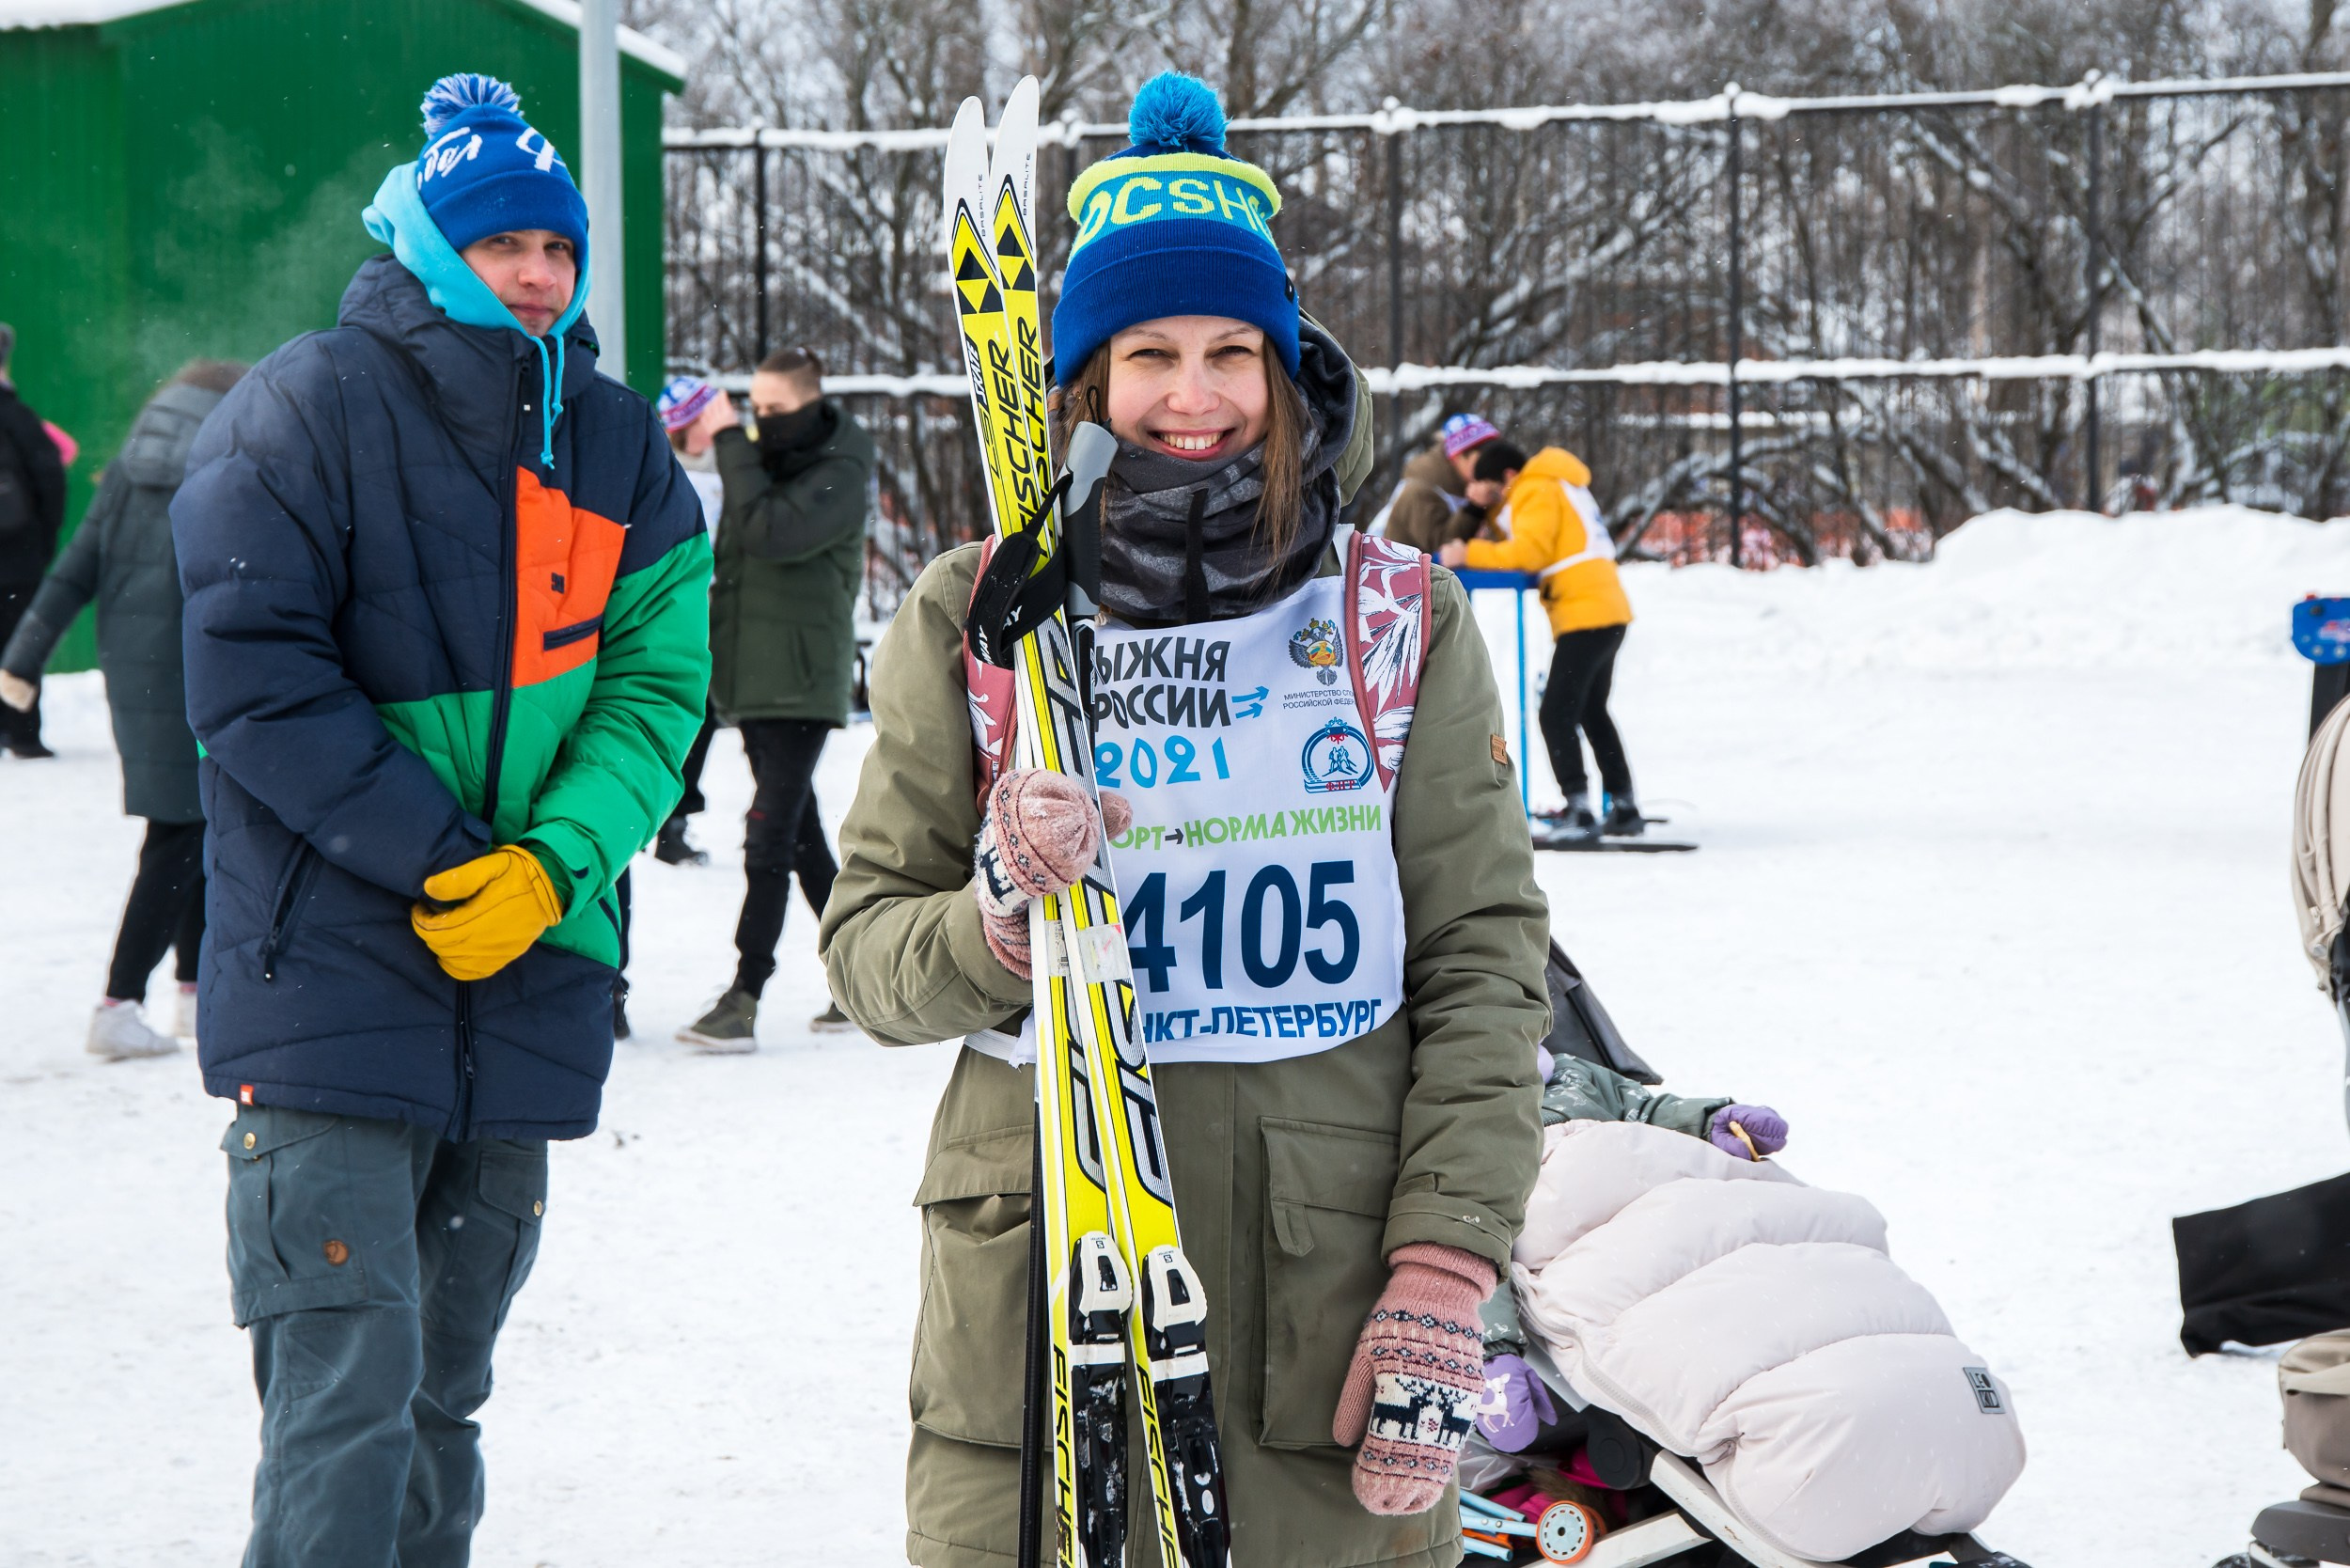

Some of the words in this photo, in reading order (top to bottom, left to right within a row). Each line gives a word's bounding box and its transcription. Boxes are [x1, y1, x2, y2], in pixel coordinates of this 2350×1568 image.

[978, 173, 986, 237] BASALITE
[1023, 152, 1031, 216] BASALITE
[966, 340, 987, 405] SKATE
[1017, 316, 1053, 539] SCHER
[1095, 636, 1231, 684] ЫЖНЯ
[1094, 683, 1231, 733] РОССИИ
[1282, 698, 1333, 710] РОССИЙСКОЙ
[1283, 689, 1342, 701] МИНИСТЕРСТВО
[1095, 735, 1230, 789] 2021
[1110, 825, 1166, 851] ОРТ
[1183, 810, 1287, 848] НОРМА
[1290, 805, 1382, 837] ЖИЗНИ
[1122, 859, 1361, 994] 4105
[1143, 998, 1382, 1043] НКТ-ПЕТЕРБУРГ
[1054, 1343, 1074, 1568] FISCHE
[1136, 1363, 1179, 1568] FISCHE
